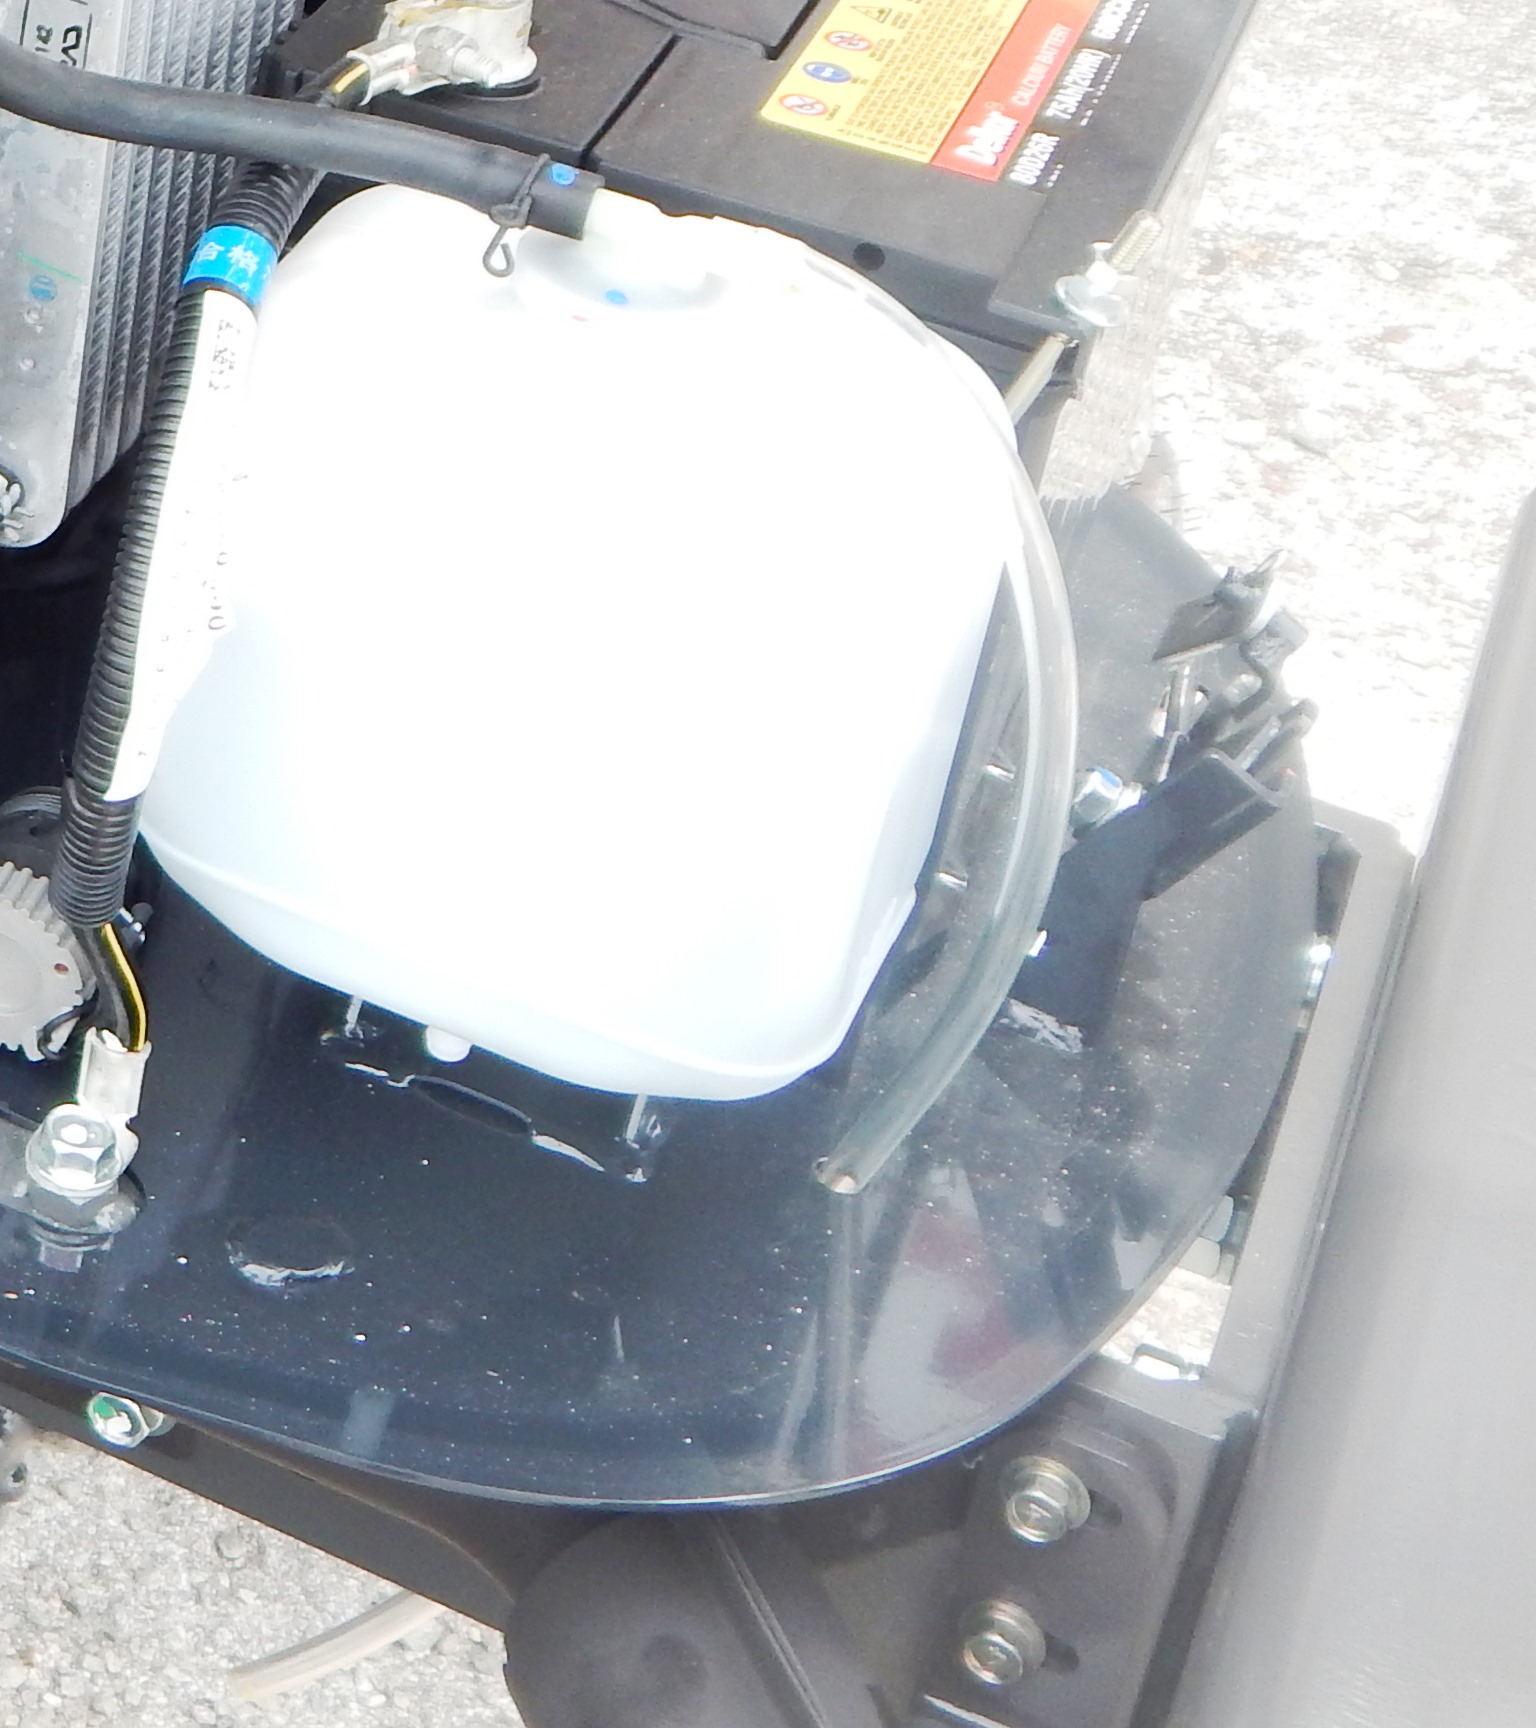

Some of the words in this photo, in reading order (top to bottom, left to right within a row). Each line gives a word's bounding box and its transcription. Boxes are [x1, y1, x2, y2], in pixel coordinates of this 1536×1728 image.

[1011, 62, 1050, 106] CALCIUM
[1035, 22, 1073, 65] BATTERY
[1010, 132, 1060, 186] 80D26R
